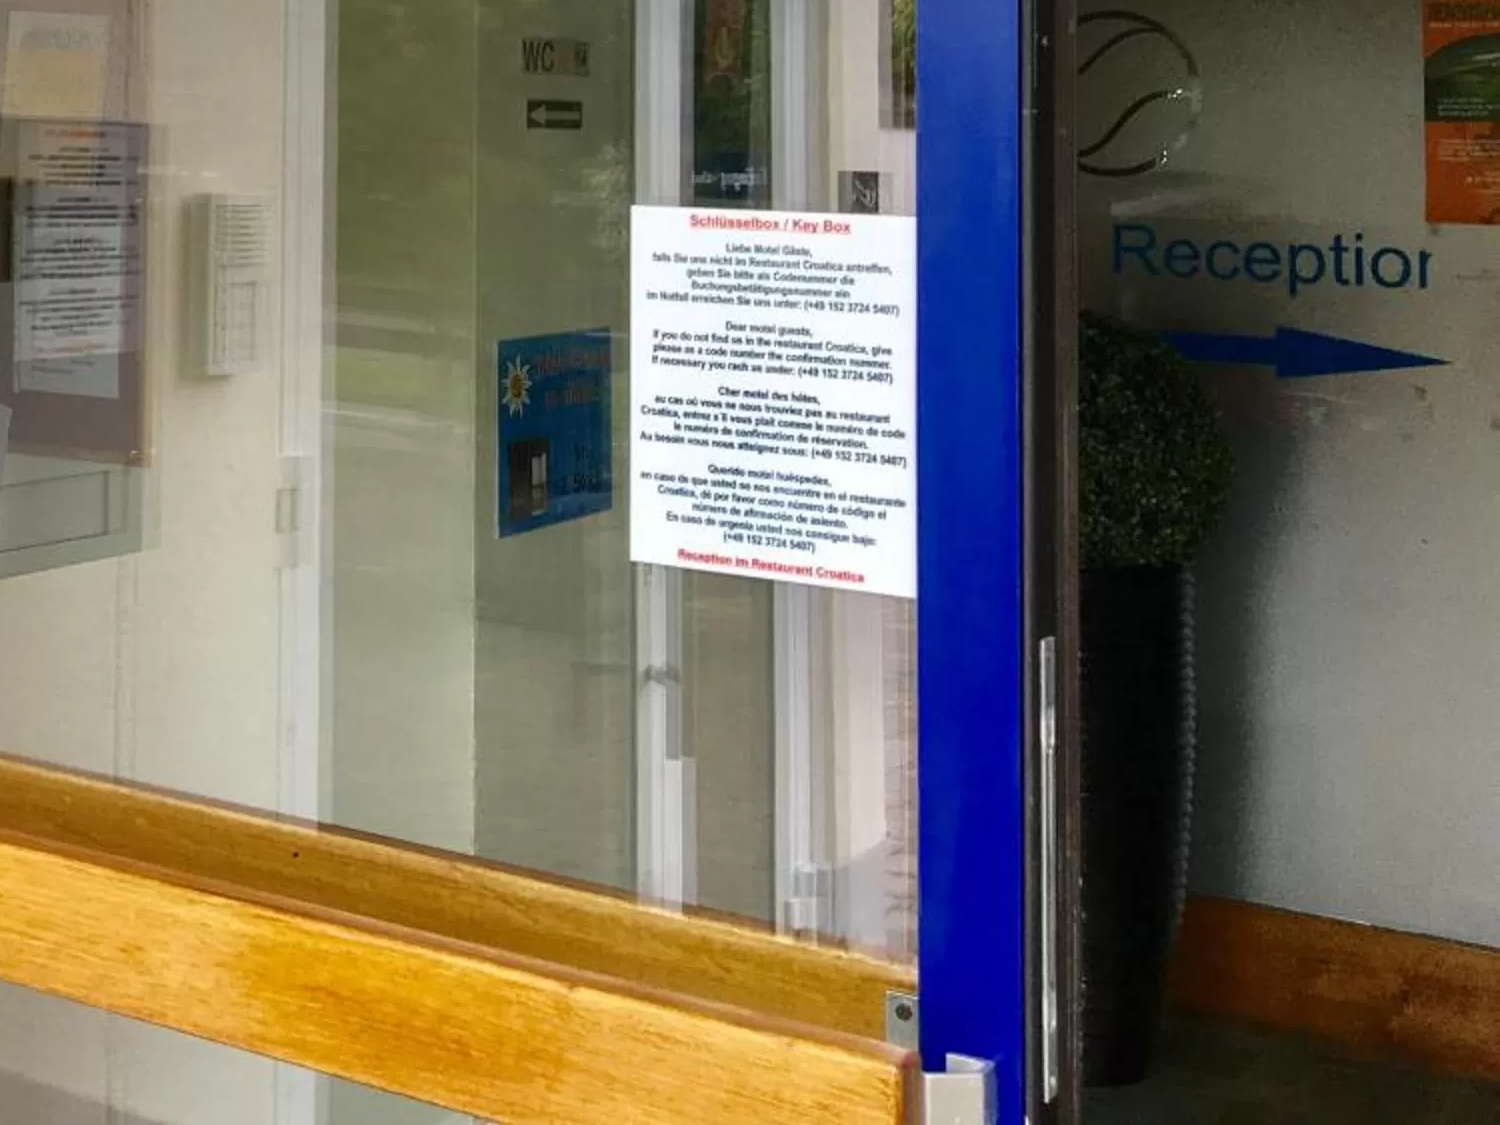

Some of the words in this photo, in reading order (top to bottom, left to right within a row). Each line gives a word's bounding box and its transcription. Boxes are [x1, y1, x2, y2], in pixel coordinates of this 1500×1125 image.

[689, 213, 781, 231] Schlüsselbox
[791, 218, 819, 236] Key
[822, 219, 851, 234] Box
[677, 548, 733, 569] Reception
[751, 558, 814, 576] Restaurant
[816, 565, 865, 583] Croatica
